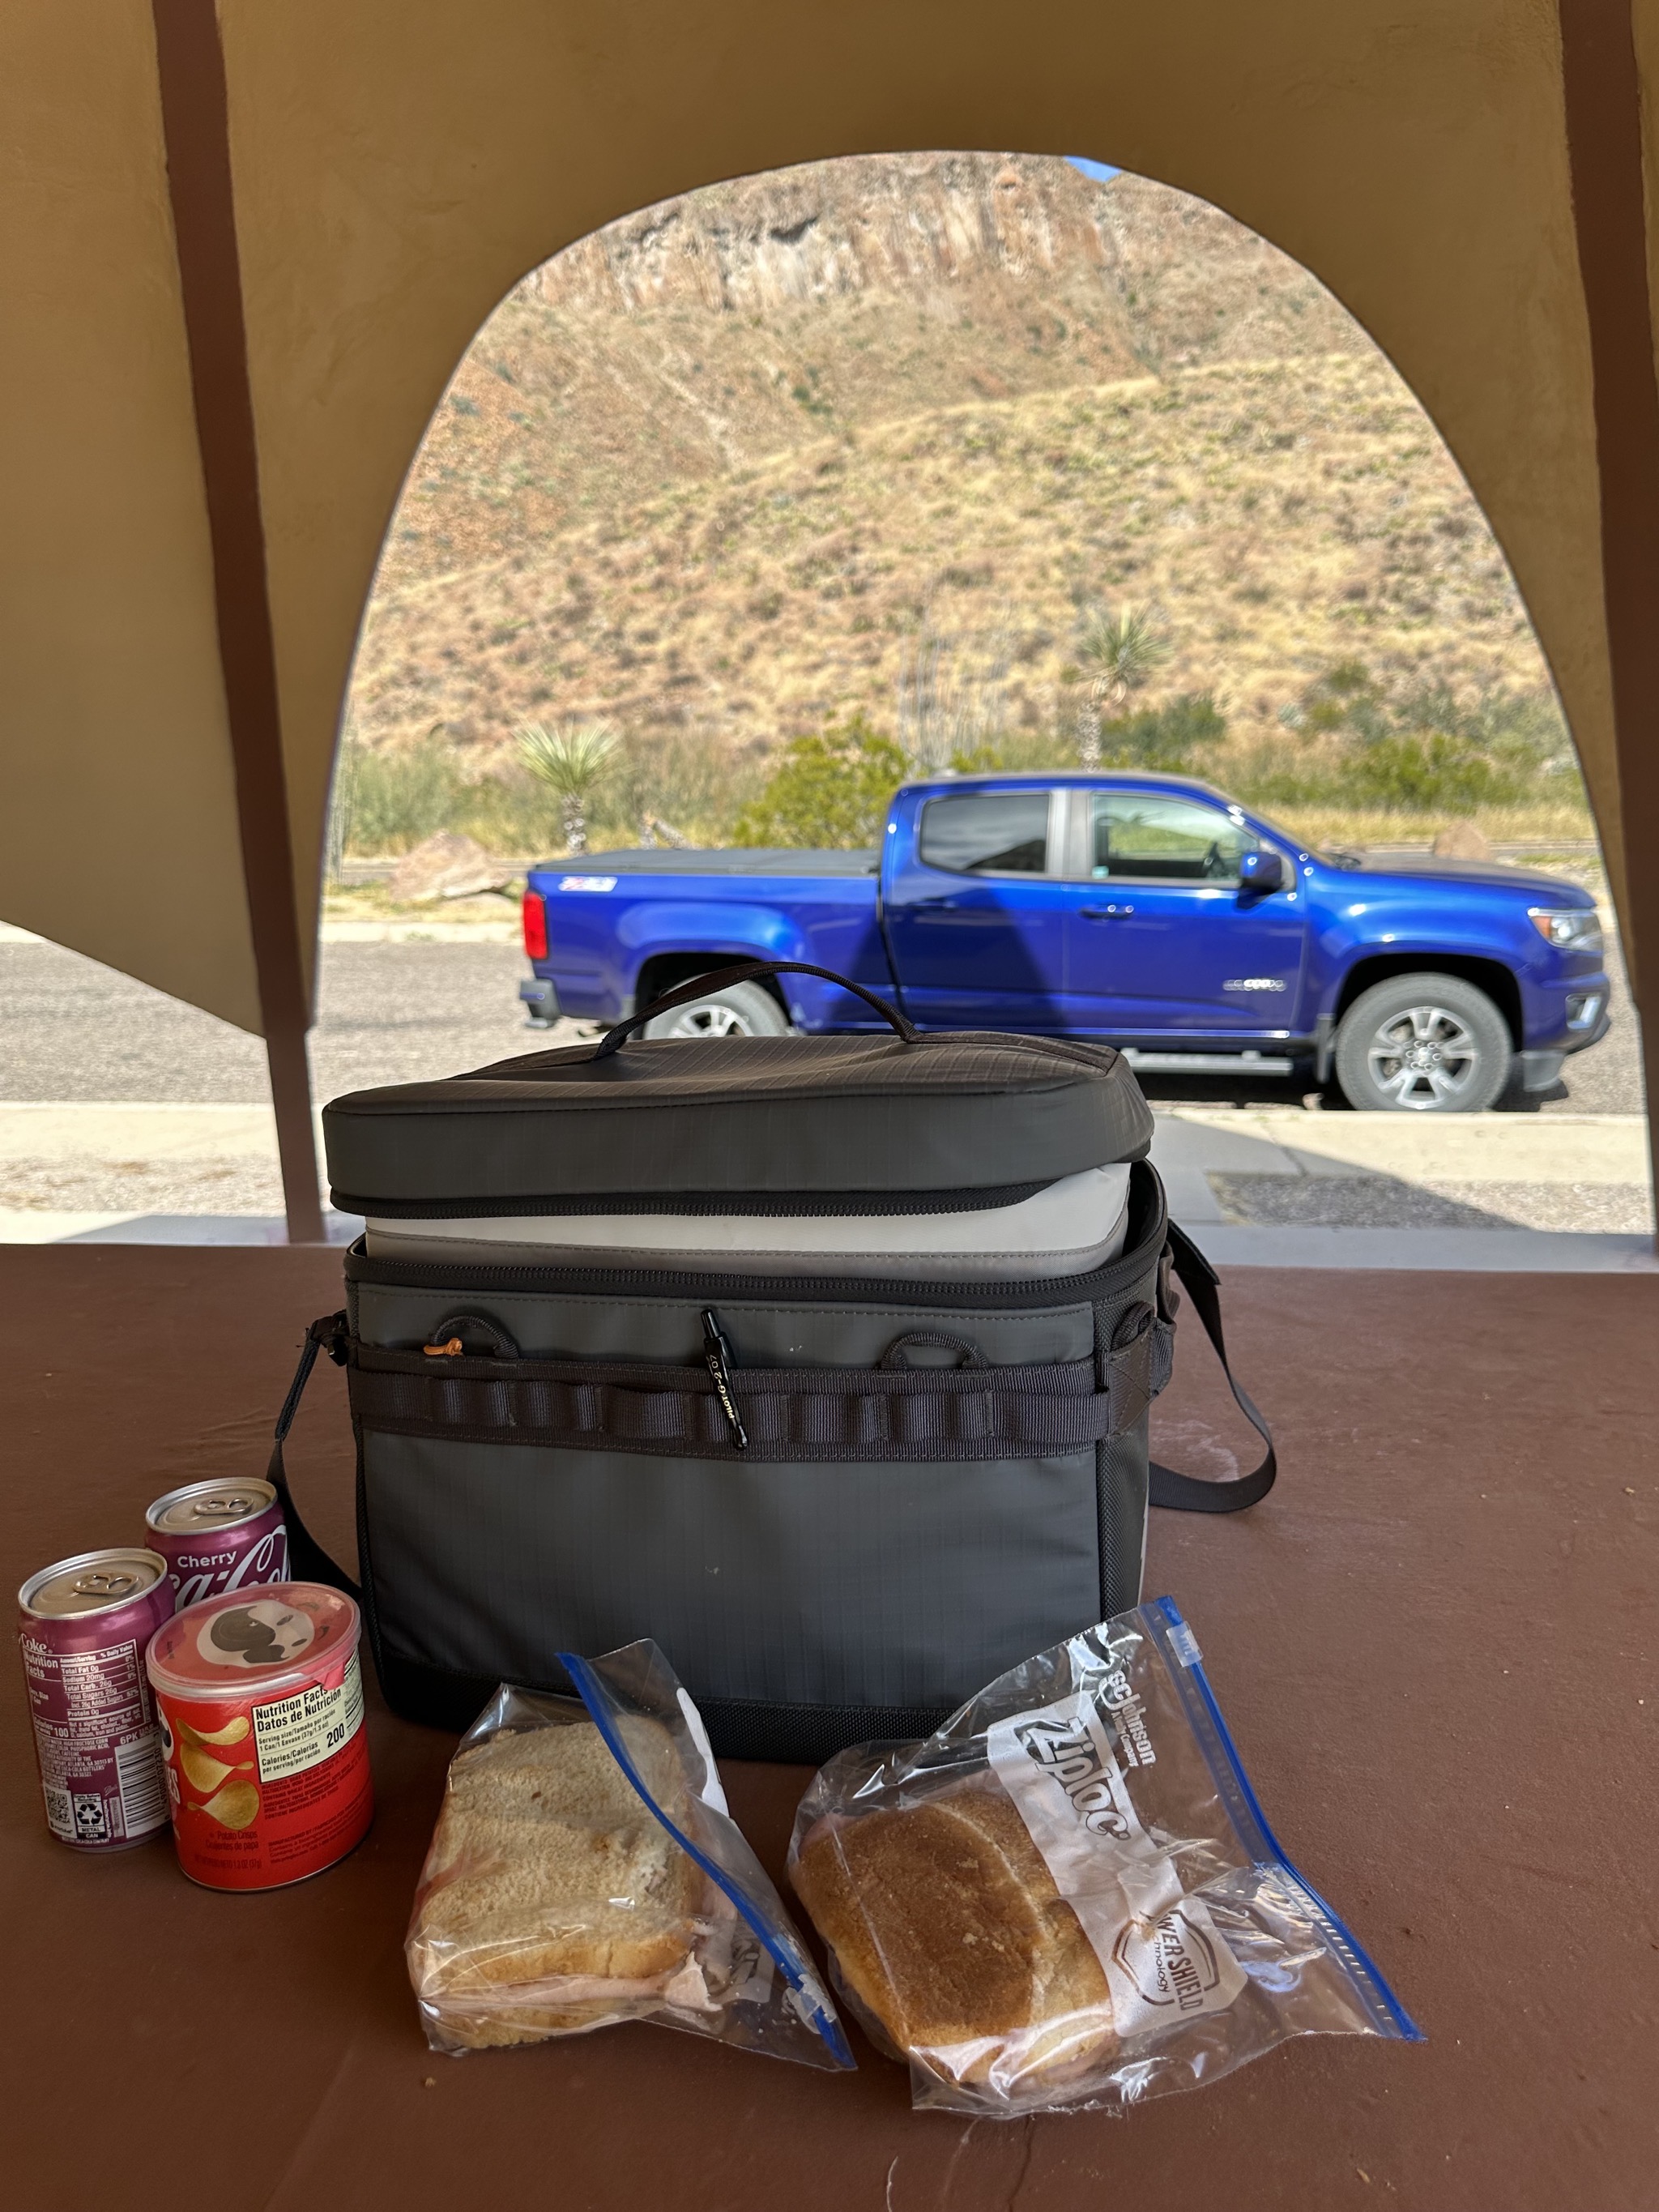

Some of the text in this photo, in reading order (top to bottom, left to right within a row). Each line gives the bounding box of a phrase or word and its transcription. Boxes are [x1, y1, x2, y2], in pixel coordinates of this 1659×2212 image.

[710, 1354, 735, 1419] PILOT G-2 07
[177, 1551, 237, 1568] Cherry
[19, 1633, 47, 1653] Coke
[23, 1652, 58, 1668] Nutrition
[87, 1673, 104, 1681] 20mg
[91, 1665, 100, 1673] 0g
[82, 1690, 104, 1699] Sugars
[256, 1685, 328, 1720] Nutrition Facts
[68, 1709, 89, 1717] Protein
[258, 1688, 341, 1732] Datos de Nutrición
[54, 1727, 69, 1738] 100
[121, 1733, 139, 1744] 6PK
[259, 1734, 280, 1744] Serving
[326, 1723, 344, 1748] 200
[262, 1764, 272, 1774] per
[1021, 1716, 1128, 1836] Ziploc
[1153, 1936, 1170, 1992] chnology
